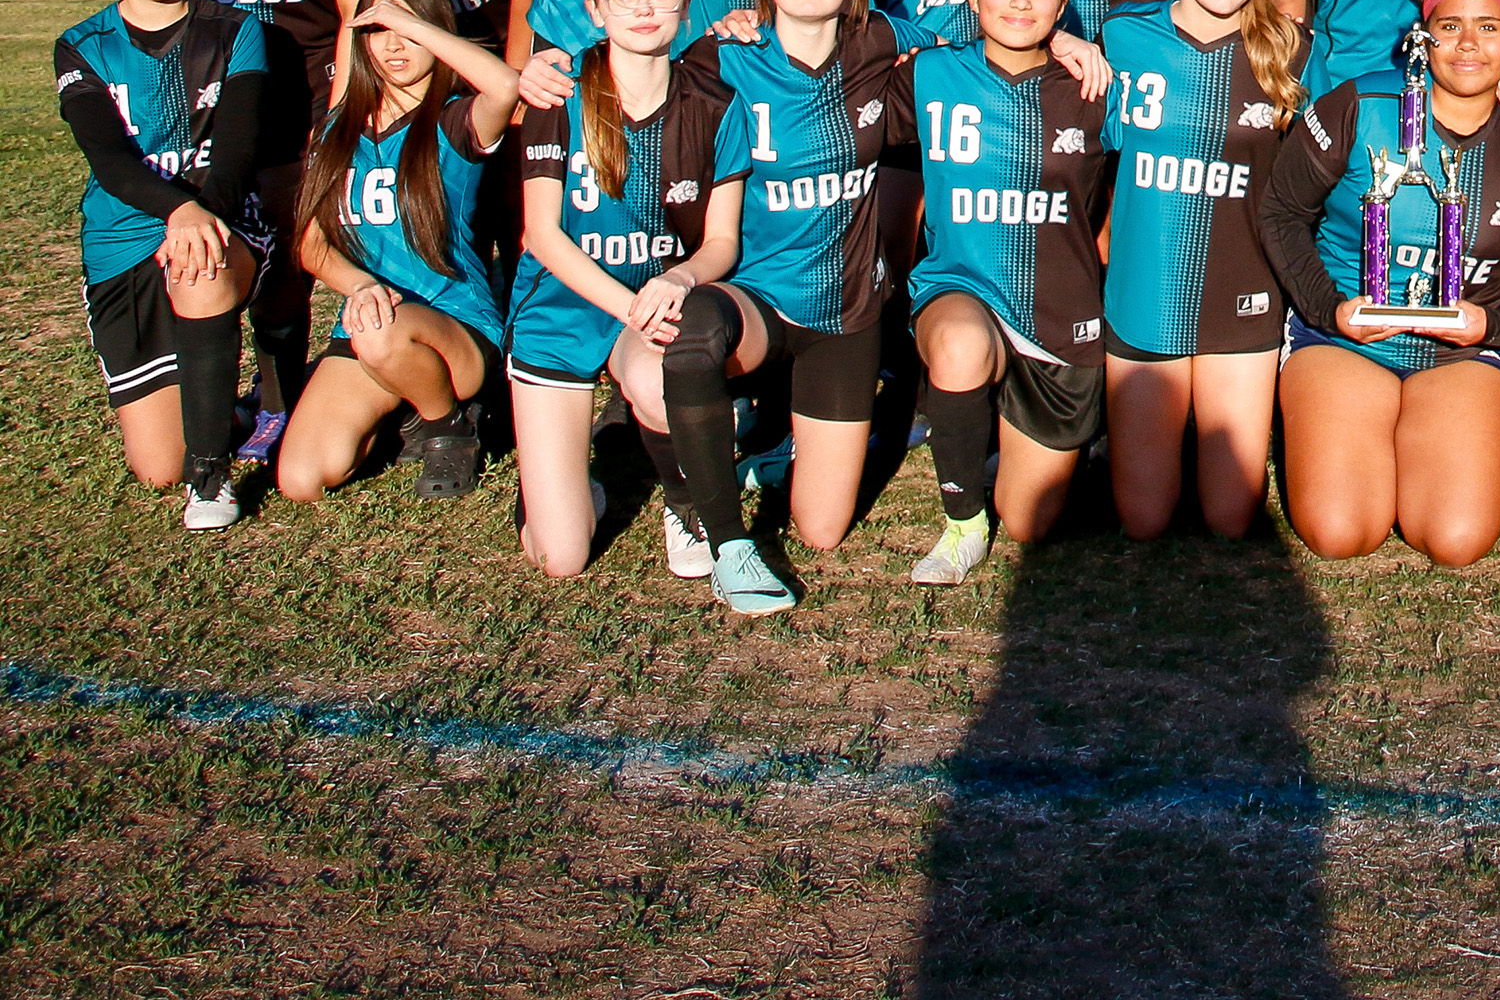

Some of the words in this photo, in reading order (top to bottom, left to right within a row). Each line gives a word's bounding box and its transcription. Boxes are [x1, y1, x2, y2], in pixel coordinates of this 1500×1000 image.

[1119, 71, 1167, 130] 13
[751, 102, 778, 162] 1
[925, 100, 982, 164] 16
[338, 167, 398, 226] 16
[1135, 151, 1250, 199] DODGE
[951, 188, 1069, 225] DODGE
